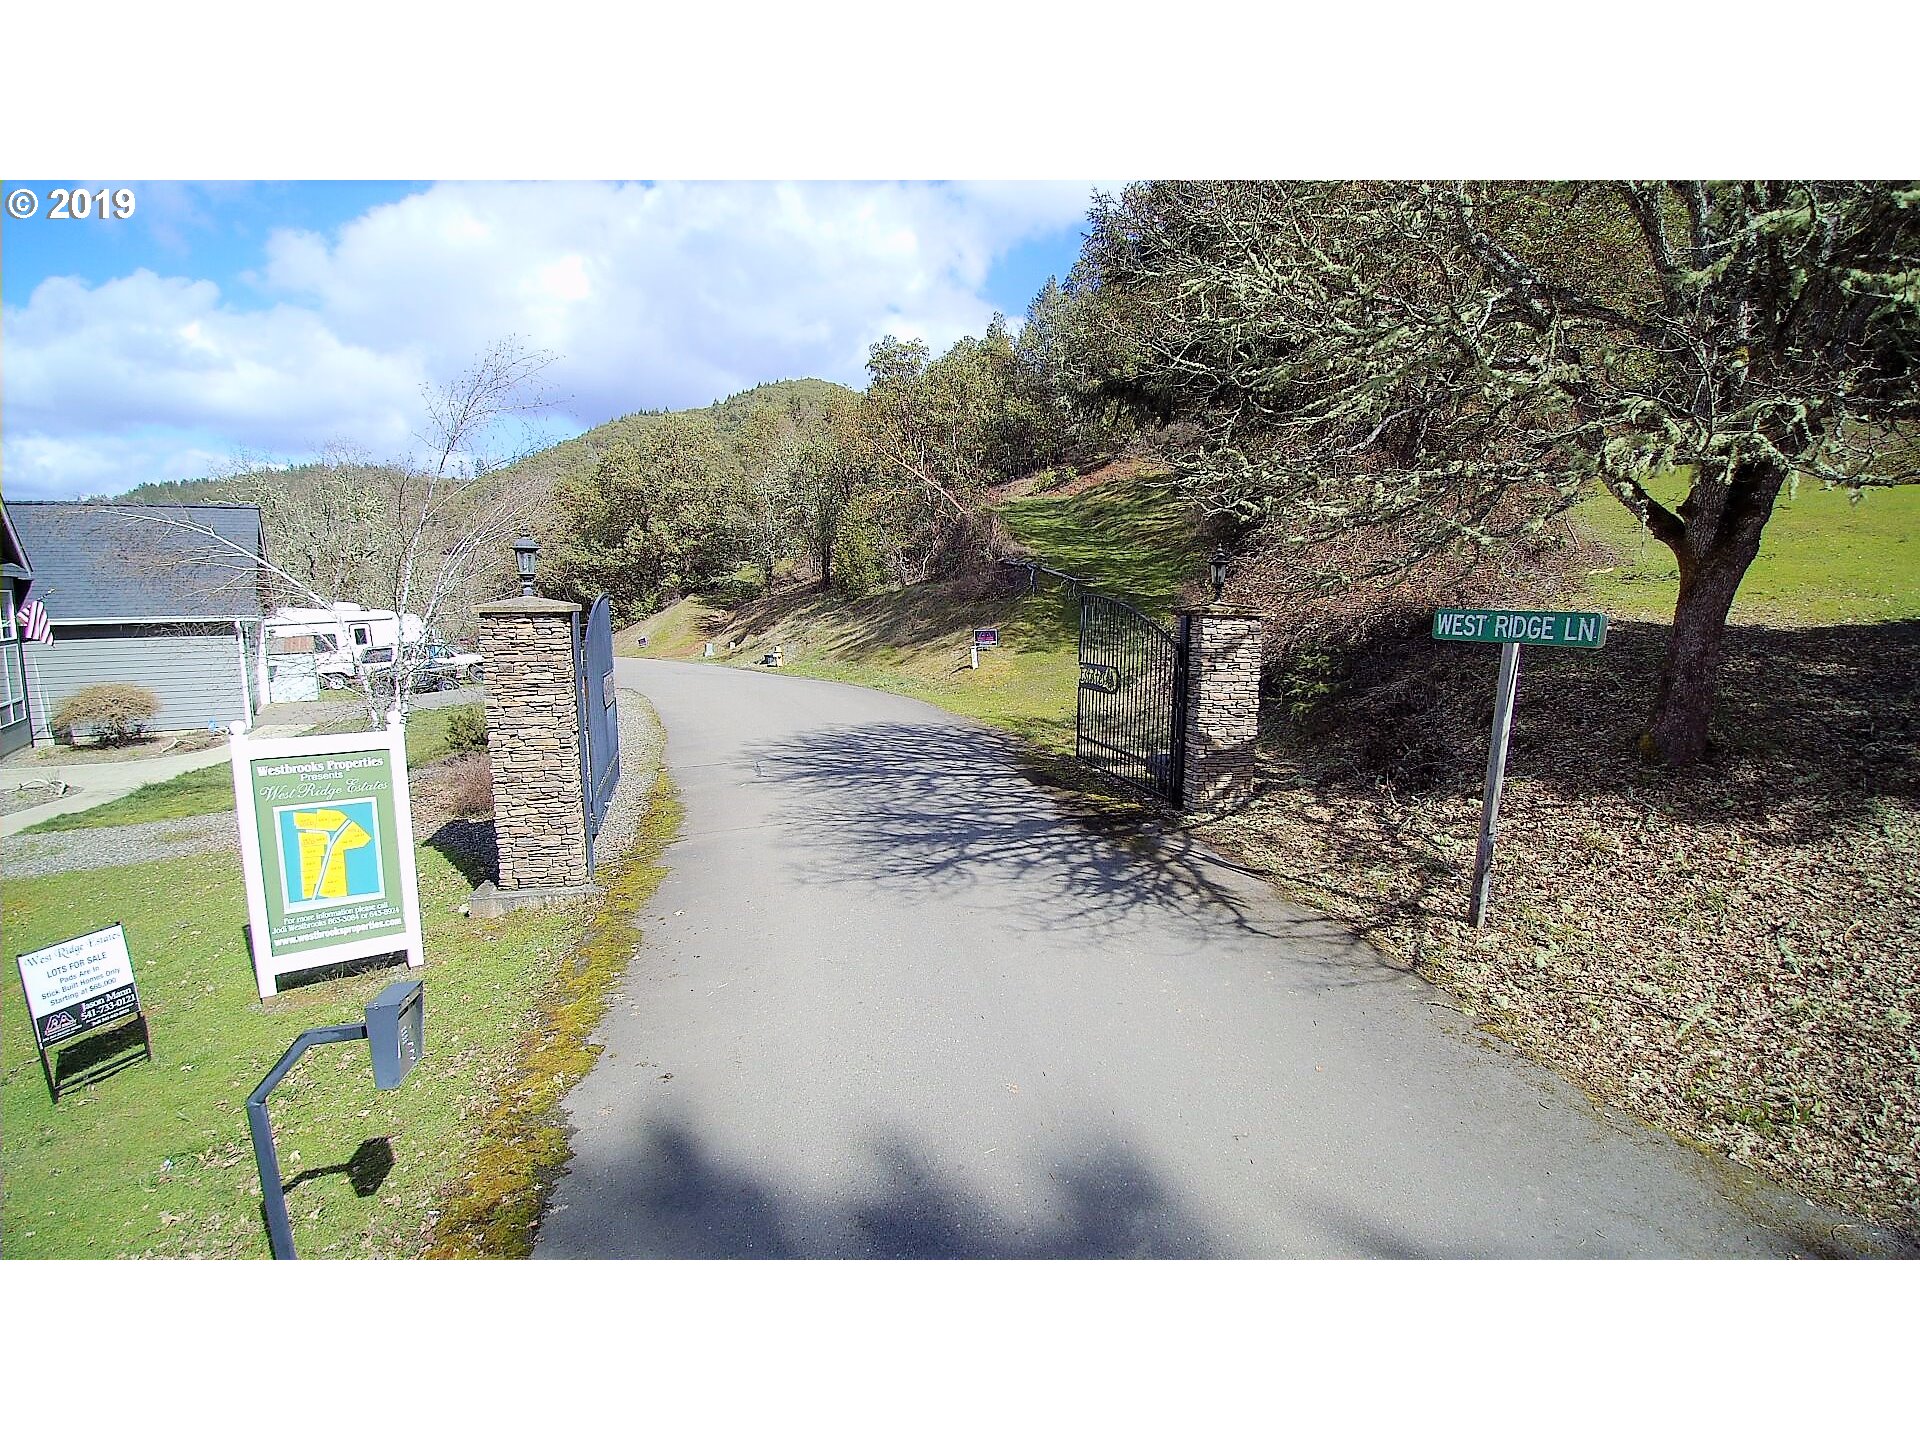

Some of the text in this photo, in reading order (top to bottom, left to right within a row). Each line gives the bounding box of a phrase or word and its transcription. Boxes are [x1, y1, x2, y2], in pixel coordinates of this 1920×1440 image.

[1437, 614, 1487, 637] WEST
[1494, 615, 1555, 640] RIDGE
[256, 757, 384, 777] Westbrooks Properties
[300, 771, 344, 781] Presents
[260, 778, 388, 801] West Ridge Estates
[297, 915, 315, 923] more
[316, 908, 354, 919] information
[355, 904, 376, 914] please
[273, 917, 402, 946] www.westbrooksproperties.com
[288, 920, 327, 932] Westbrooks
[24, 933, 121, 967] West Ridge Estates
[46, 952, 108, 979] LOTS FOR SALE
[59, 972, 77, 984] Pads
[79, 968, 92, 977] Are
[41, 967, 120, 1000] Stick Built Homes Only
[50, 990, 79, 1007] Starting
[80, 997, 104, 1012] Jason
[80, 994, 136, 1020] 541-733-0121
